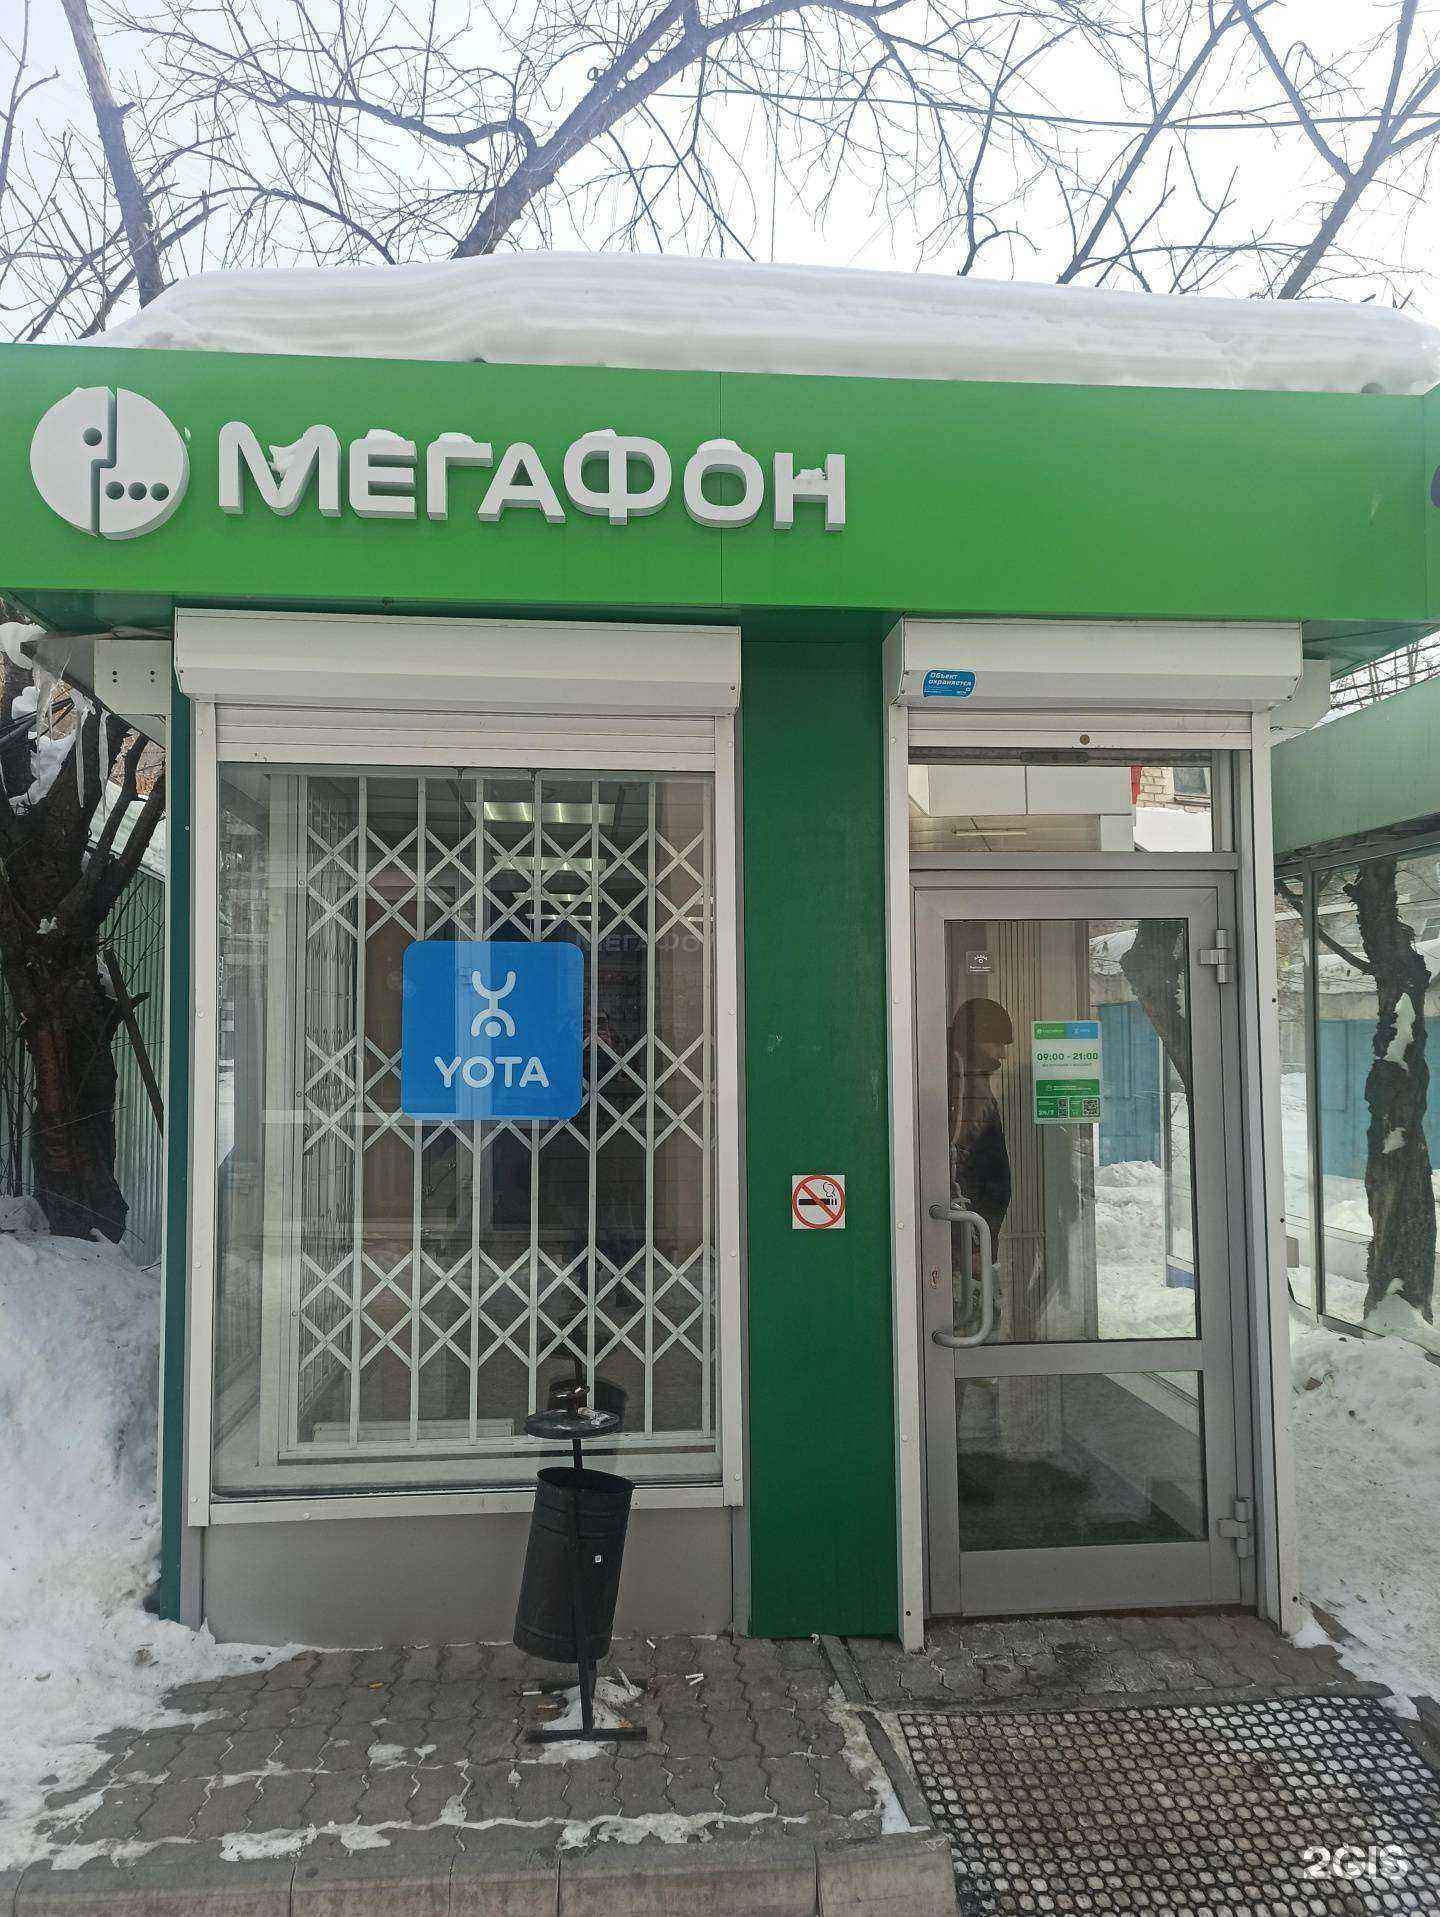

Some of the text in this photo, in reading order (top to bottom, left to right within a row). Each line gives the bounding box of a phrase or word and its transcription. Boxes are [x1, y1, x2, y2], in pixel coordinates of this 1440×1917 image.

[218, 421, 846, 531] МЕГАФОН
[930, 672, 958, 680] Объект
[928, 679, 972, 687] охраняется
[1036, 1052, 1064, 1061] 09:00
[1073, 1052, 1098, 1060] 21:00
[434, 1056, 549, 1088] YOTA
